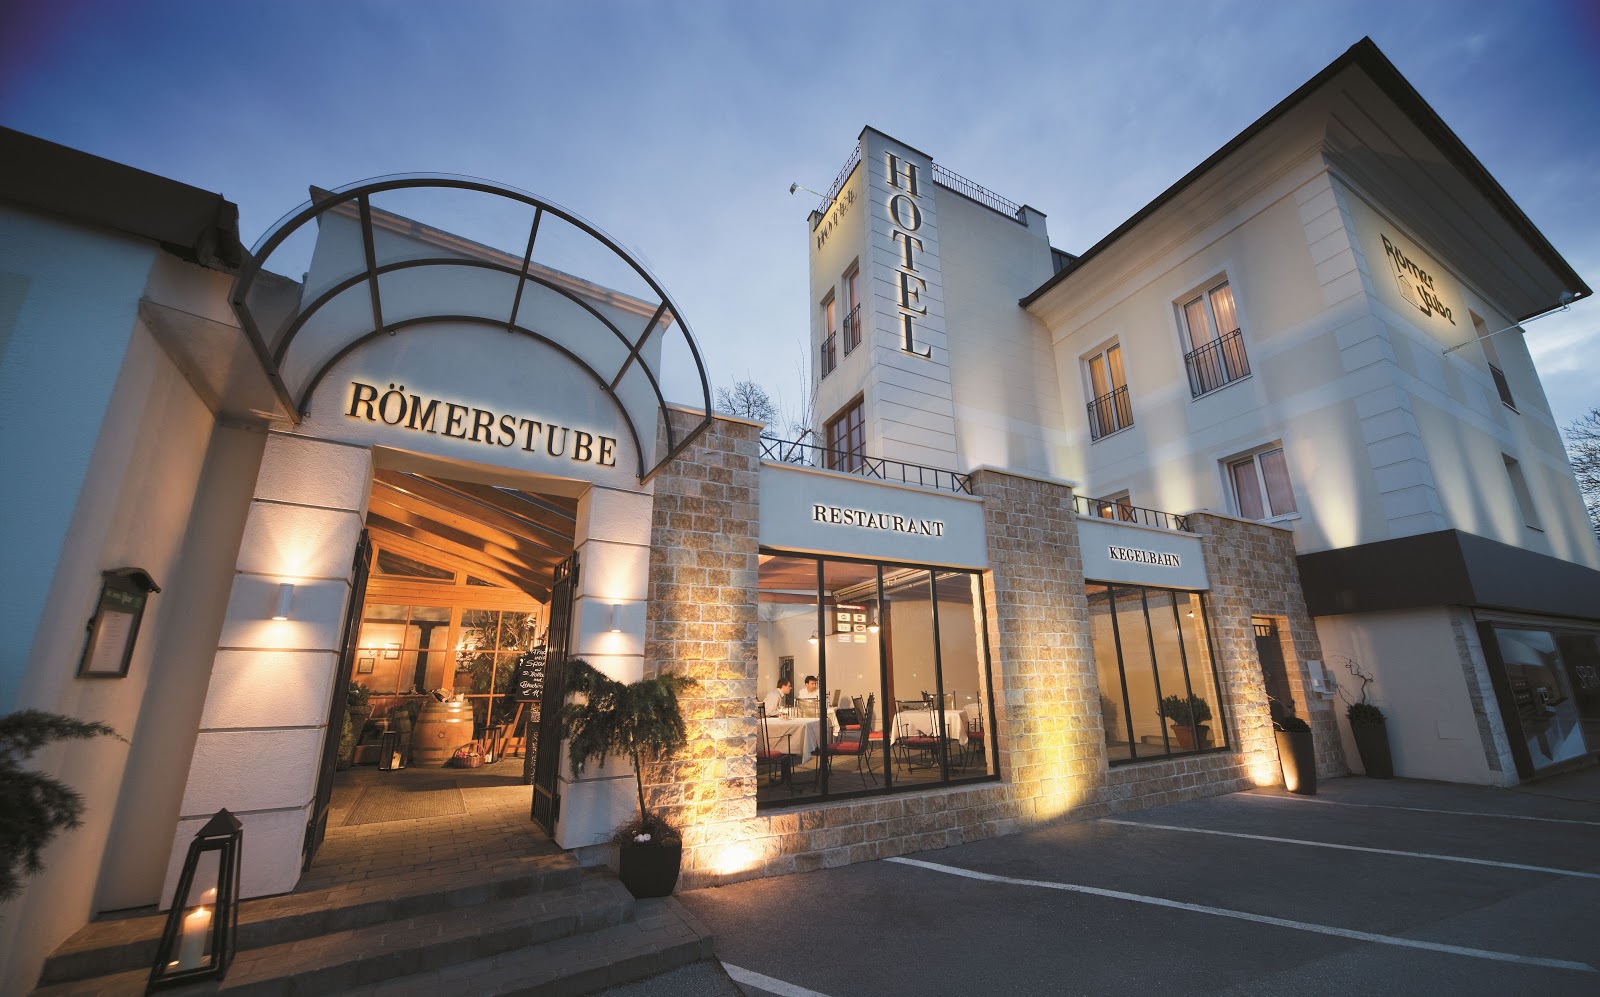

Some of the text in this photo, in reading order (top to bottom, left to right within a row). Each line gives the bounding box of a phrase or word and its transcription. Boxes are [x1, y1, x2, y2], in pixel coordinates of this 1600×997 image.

[817, 187, 857, 252] HOTEL
[885, 151, 931, 359] HOTEL
[345, 382, 617, 467] RÖMERSTUBE
[813, 504, 944, 537] RESTAURANT
[1109, 545, 1180, 567] KEGELBAHN
